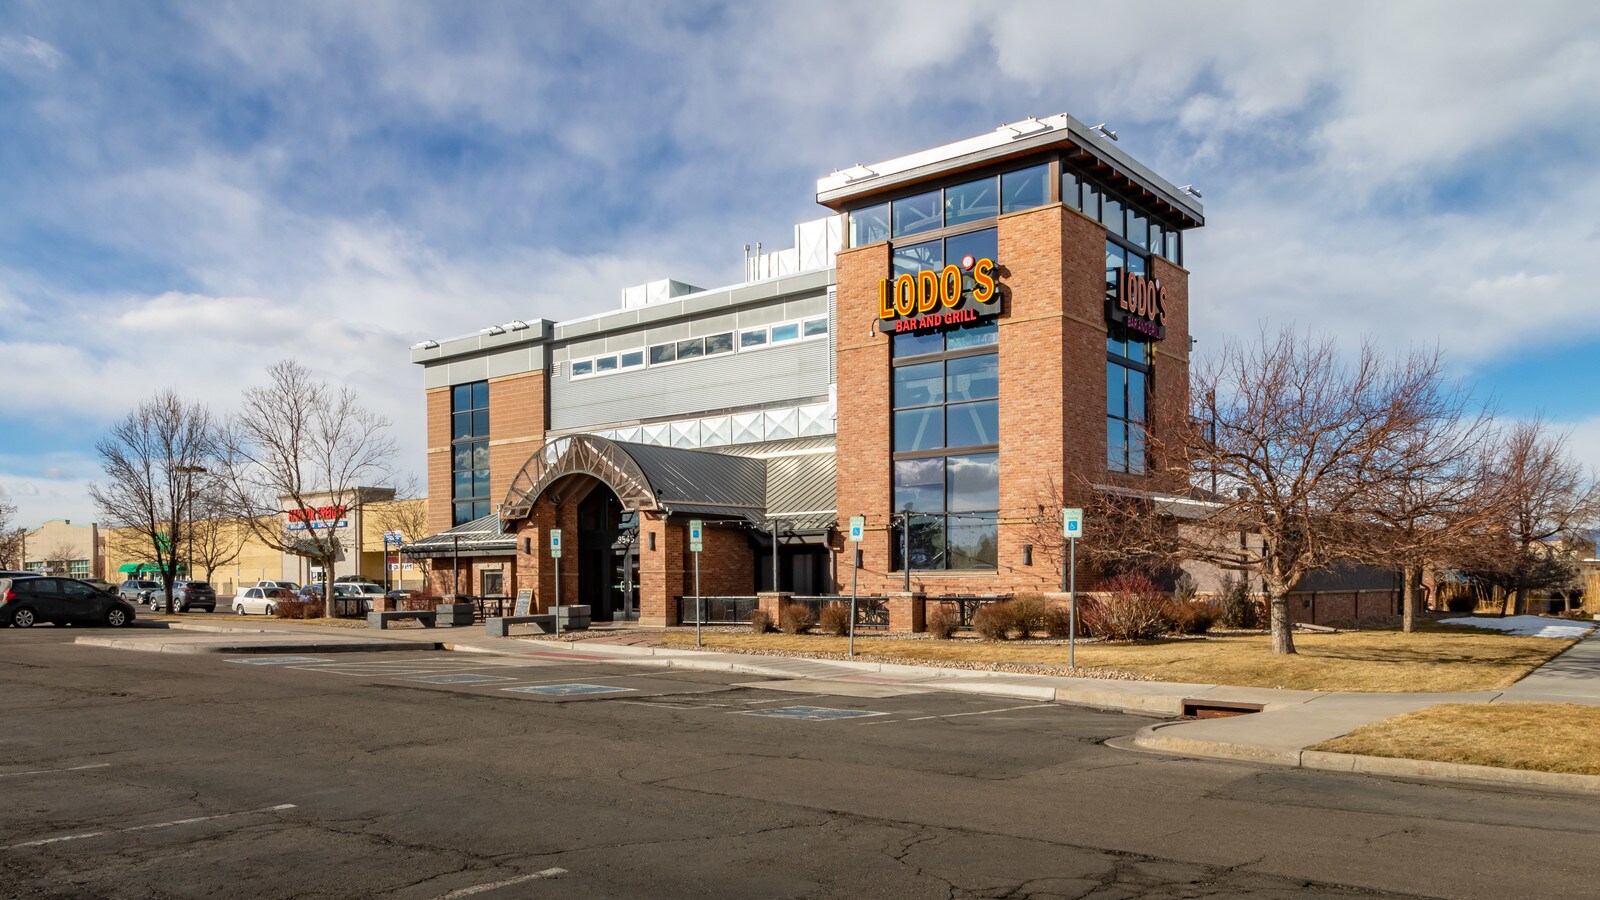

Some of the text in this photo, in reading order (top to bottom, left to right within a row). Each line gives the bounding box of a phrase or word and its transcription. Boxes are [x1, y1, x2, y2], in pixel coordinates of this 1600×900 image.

[879, 254, 995, 319] LODO'S
[1120, 267, 1167, 326] LODO'S
[895, 308, 977, 333] BAR AND GRILL
[1127, 315, 1137, 329] BAR
[1138, 320, 1147, 334] AND
[288, 508, 315, 522] HAROR
